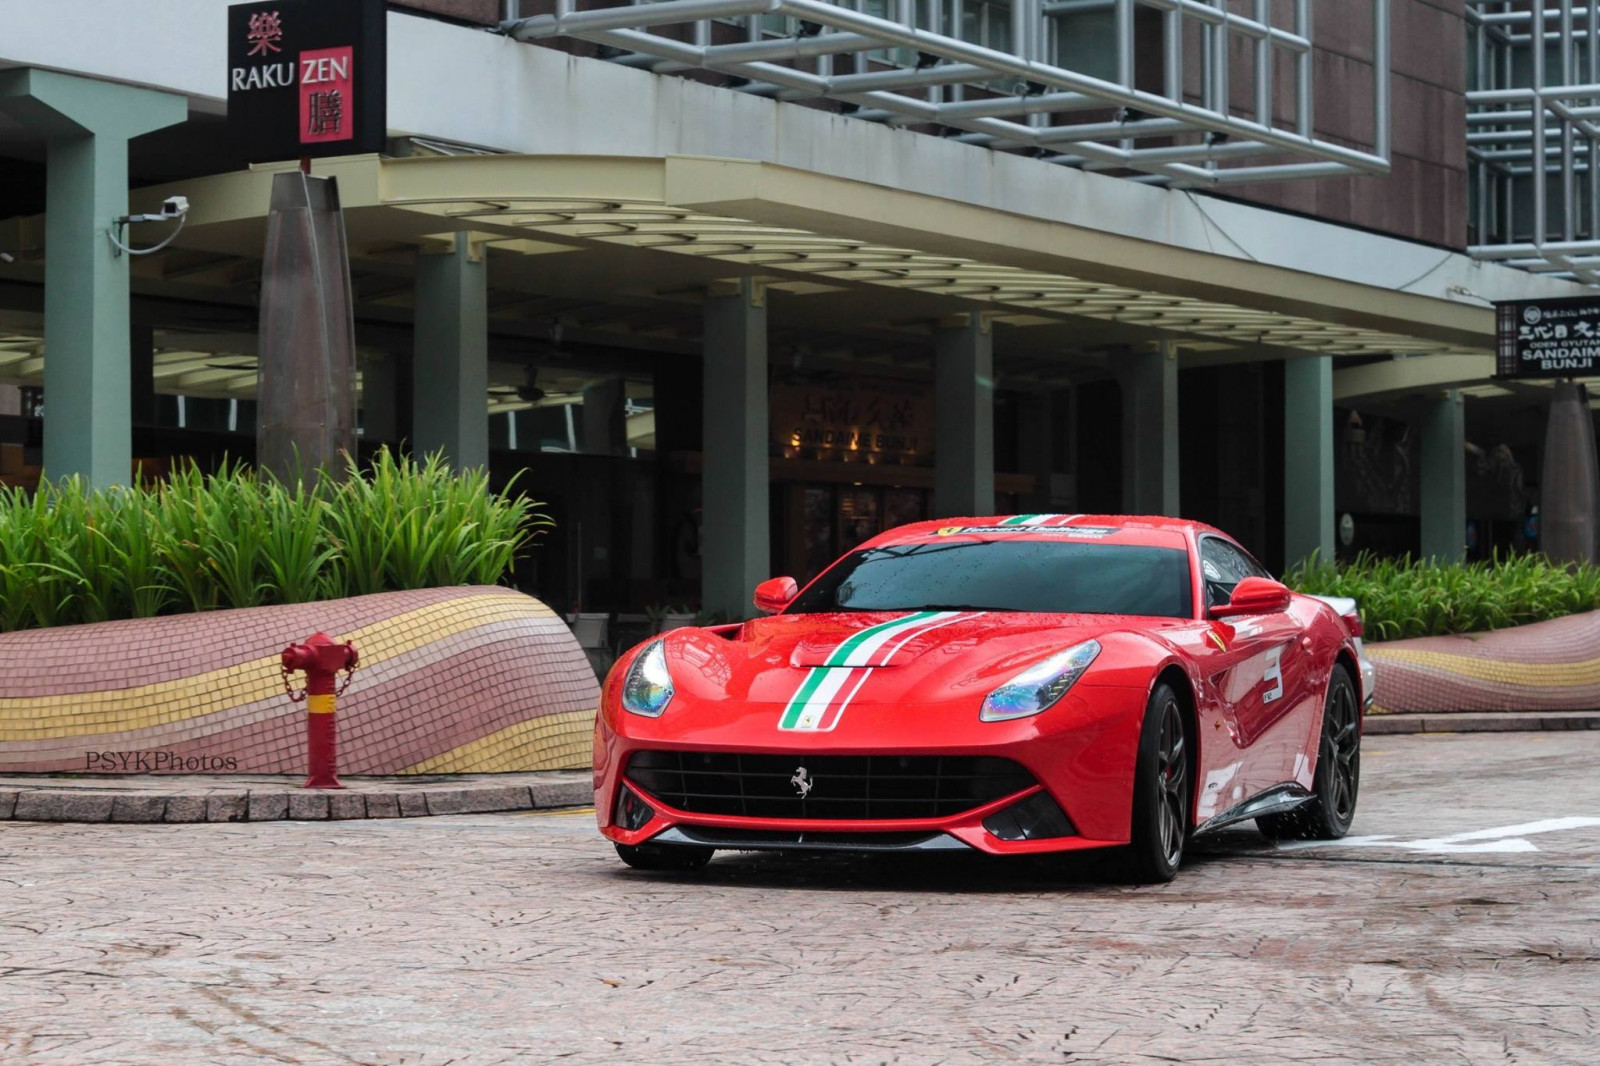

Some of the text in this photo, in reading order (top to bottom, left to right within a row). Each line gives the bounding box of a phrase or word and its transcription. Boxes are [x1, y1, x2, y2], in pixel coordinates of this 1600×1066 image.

[247, 11, 282, 56] 樂
[232, 56, 348, 91] RAKU ZEN
[1522, 346, 1600, 360] SANDAIM
[1541, 358, 1592, 369] BUNJI
